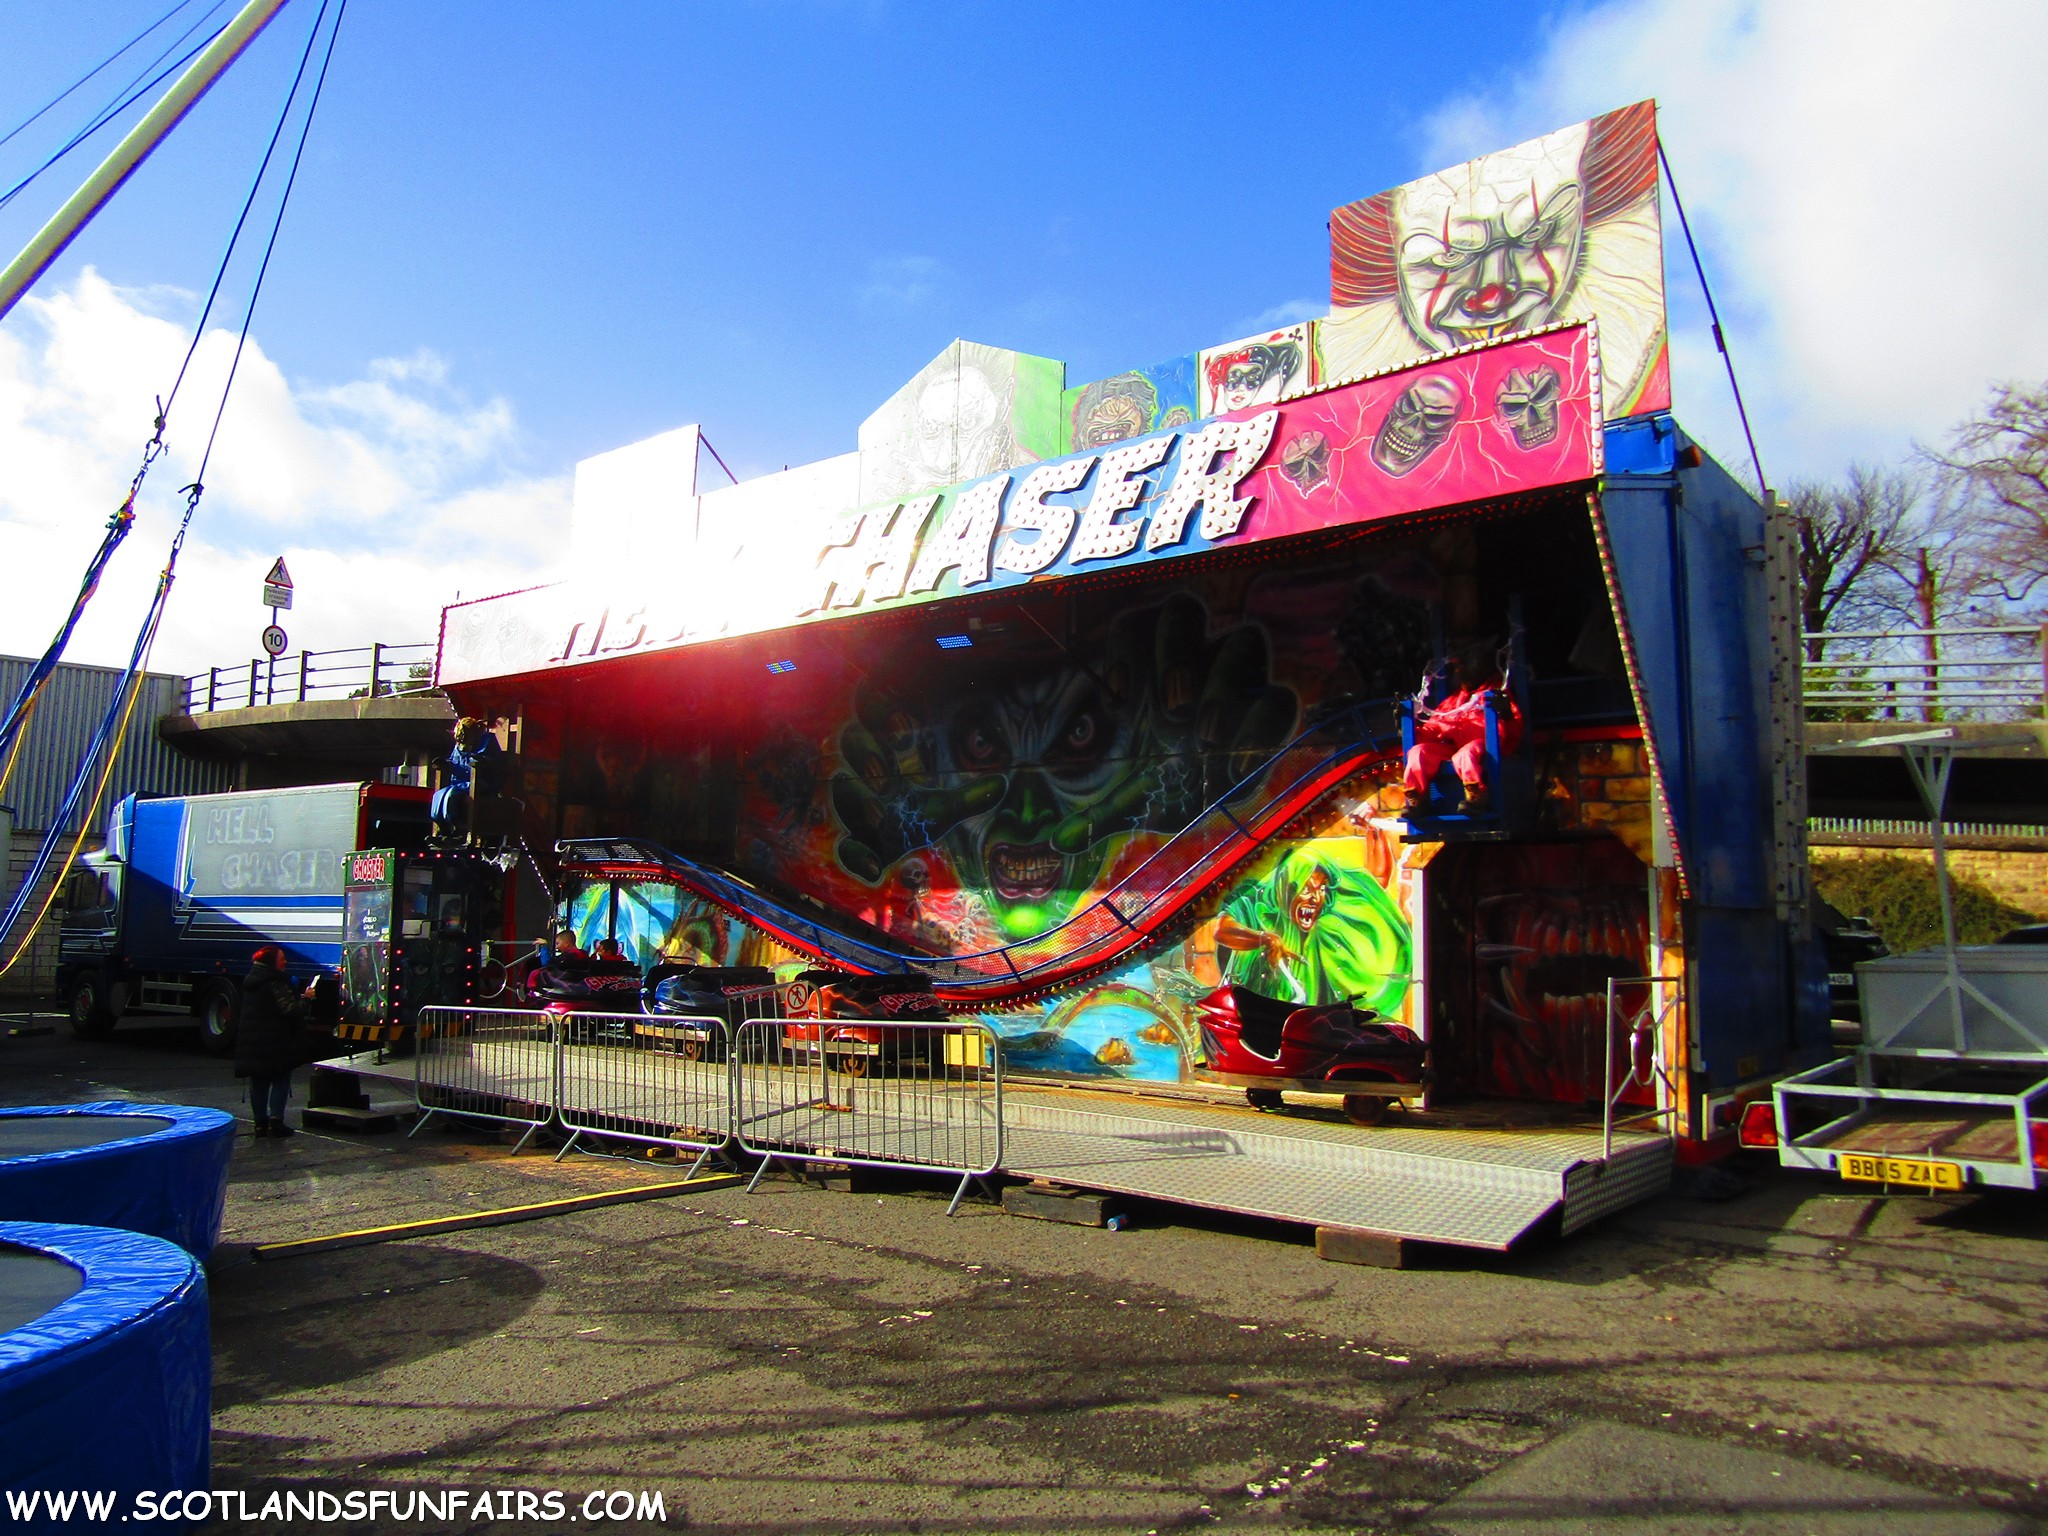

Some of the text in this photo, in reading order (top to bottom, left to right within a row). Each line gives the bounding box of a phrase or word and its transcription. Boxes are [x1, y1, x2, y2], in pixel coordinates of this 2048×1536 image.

[796, 410, 1280, 617] CHASER
[268, 633, 282, 647] 10
[206, 804, 275, 844] HELL
[221, 848, 337, 890] CHASER
[1907, 1164, 1948, 1184] ZAC
